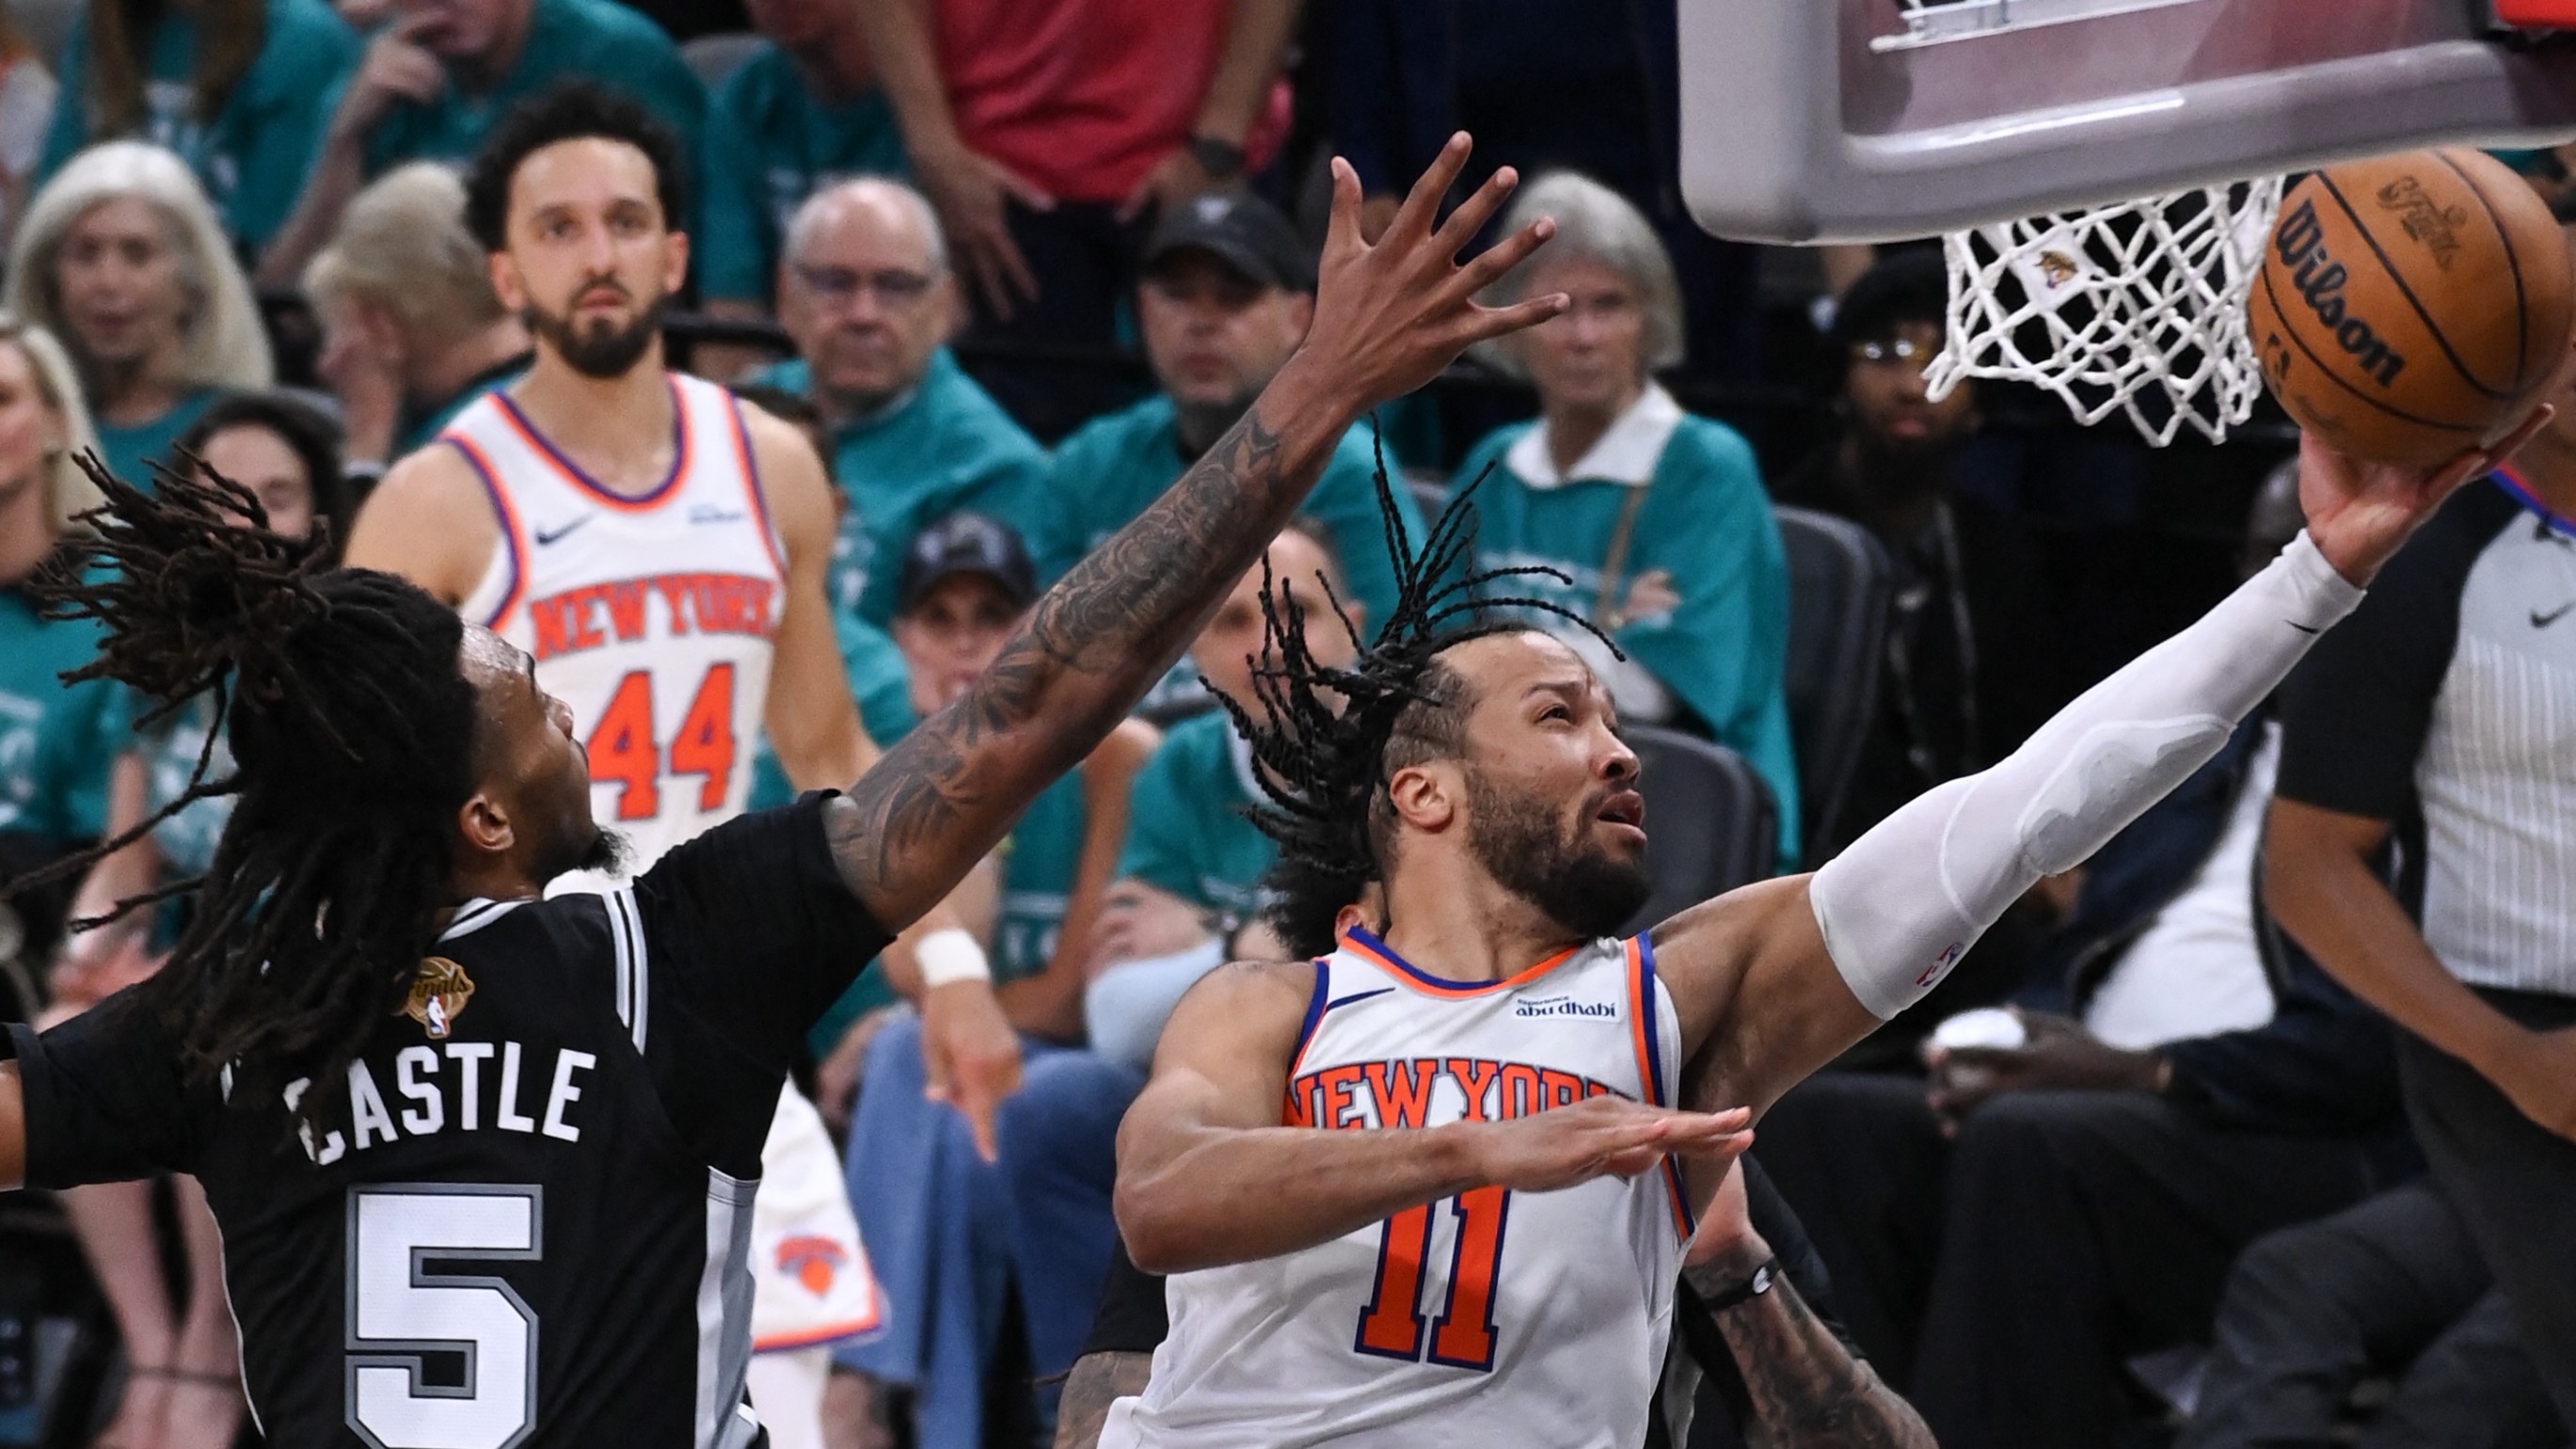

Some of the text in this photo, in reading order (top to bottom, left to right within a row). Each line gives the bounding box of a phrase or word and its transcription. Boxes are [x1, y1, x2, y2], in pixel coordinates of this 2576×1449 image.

[2275, 198, 2406, 389] Wilson
[531, 571, 776, 661] NEW YORK
[584, 661, 737, 822] 44
[1516, 1002, 1615, 1017] abu dhabi
[282, 1041, 597, 1166] CASTLE
[1281, 1057, 1638, 1129] NEW YOR
[344, 1181, 543, 1449] 5
[1354, 1185, 1512, 1373] 11
